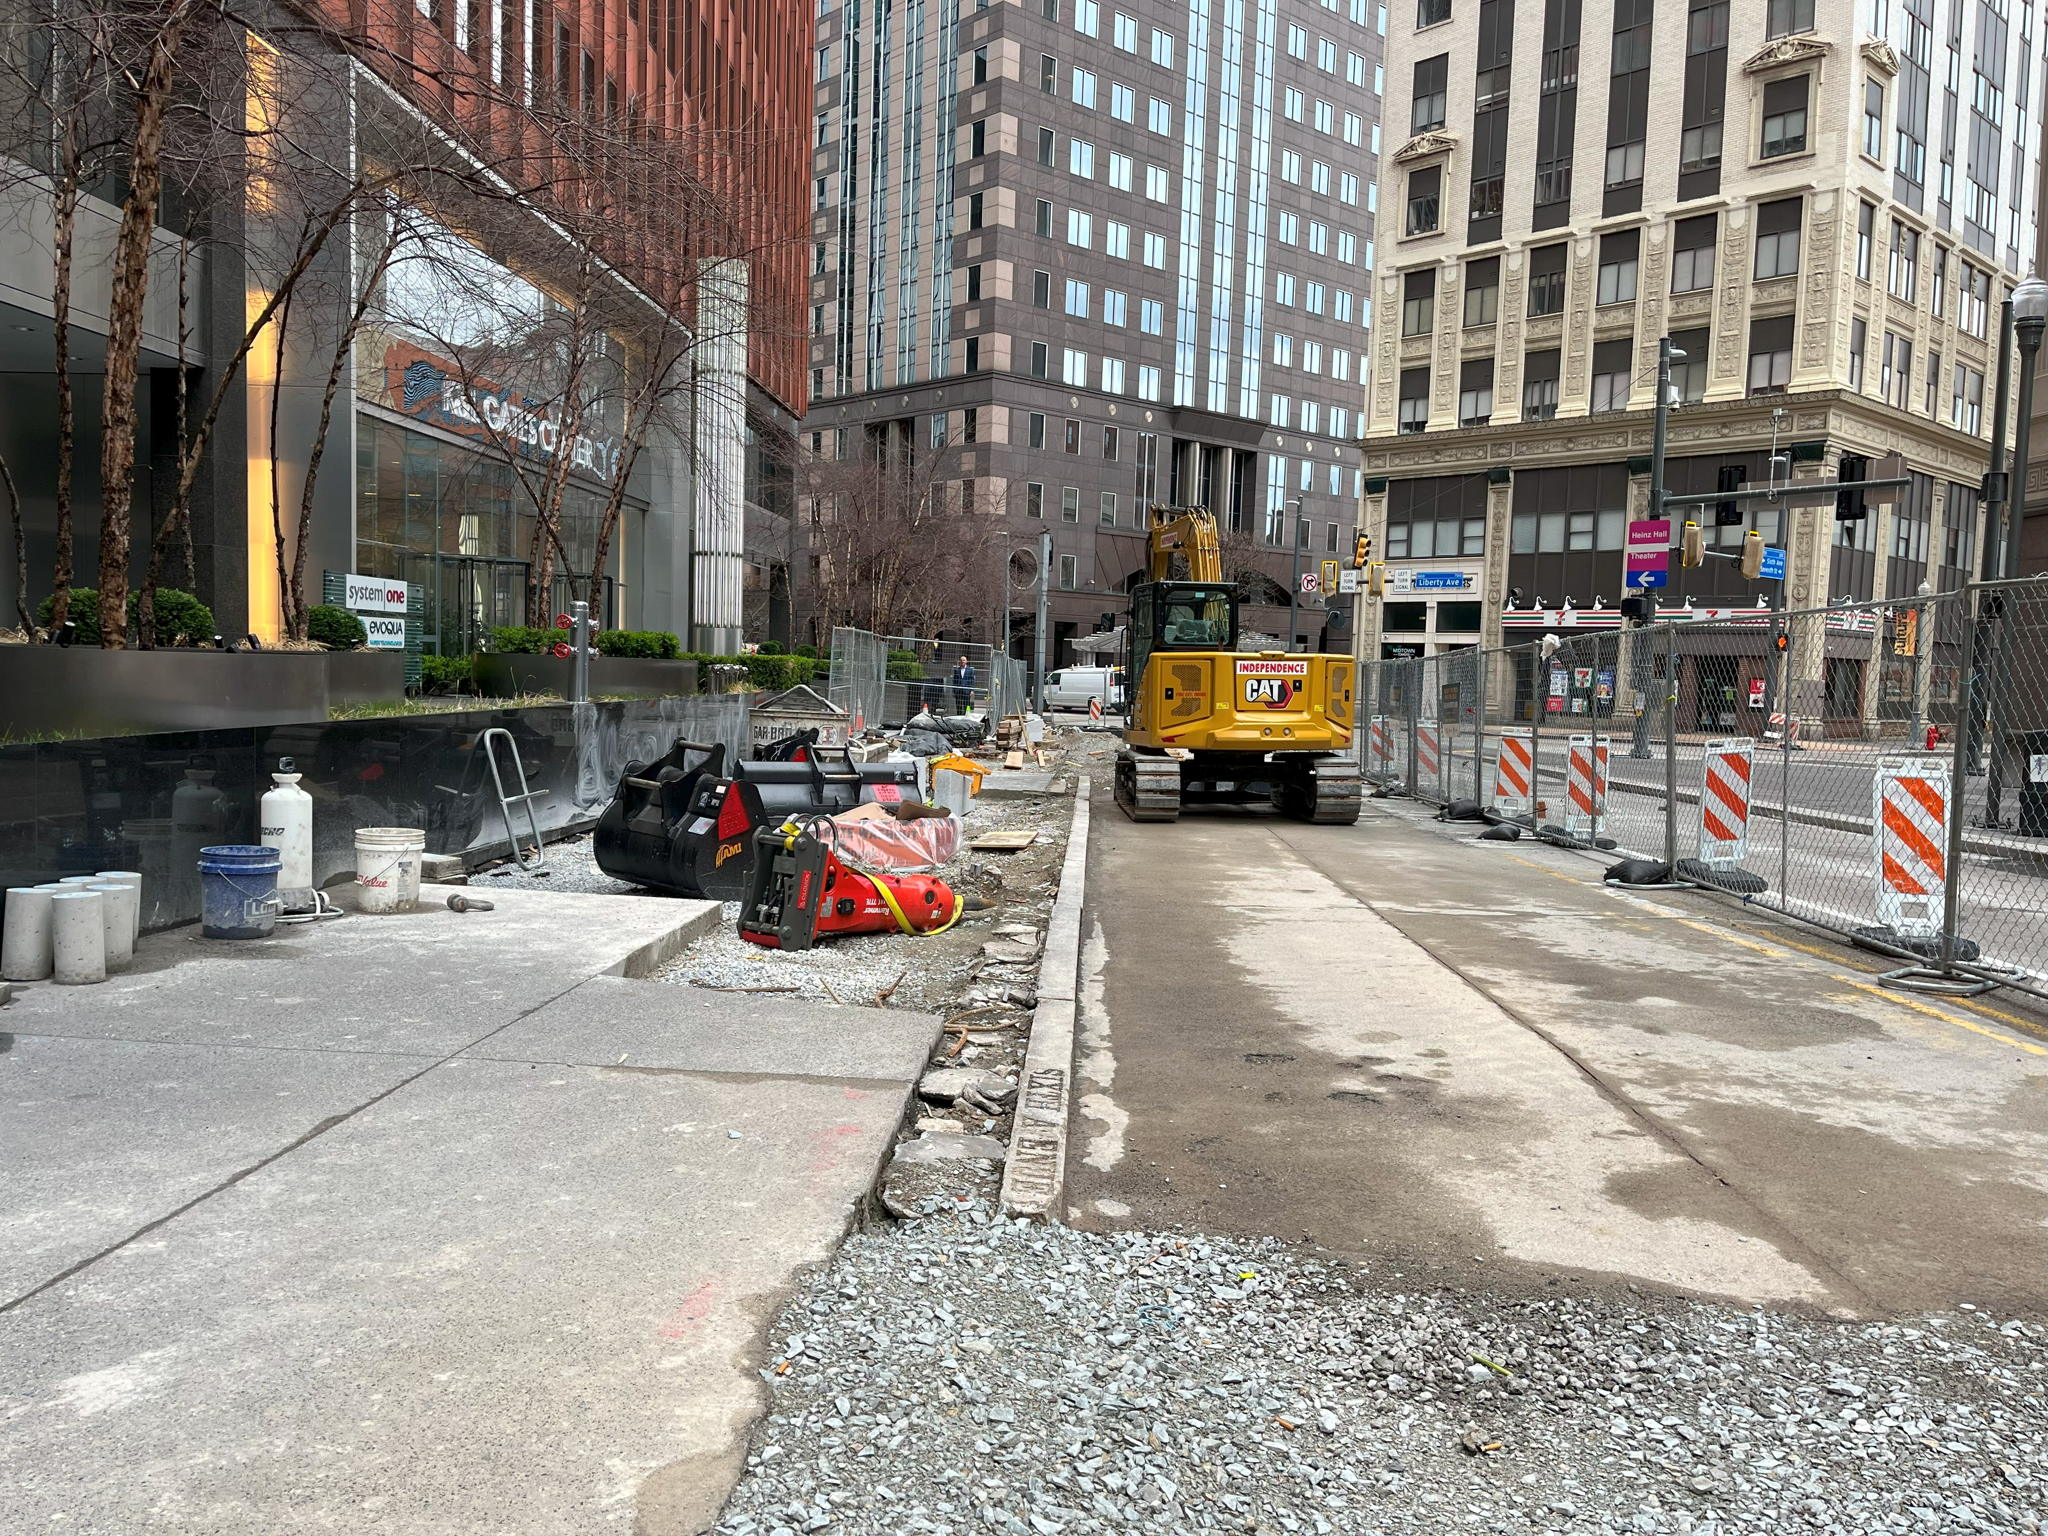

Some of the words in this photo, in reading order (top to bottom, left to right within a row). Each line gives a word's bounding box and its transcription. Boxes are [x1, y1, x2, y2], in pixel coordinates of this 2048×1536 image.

[1653, 530, 1668, 538] Hall
[1631, 552, 1657, 560] Theater
[1419, 579, 1444, 588] Liberty
[349, 585, 383, 606] system
[386, 589, 405, 604] one
[1239, 663, 1305, 673] INDEPENDENCE
[1246, 679, 1282, 703] CAT
[1025, 1068, 1064, 1113] SIXTH
[1010, 1114, 1060, 1194] AENUE
